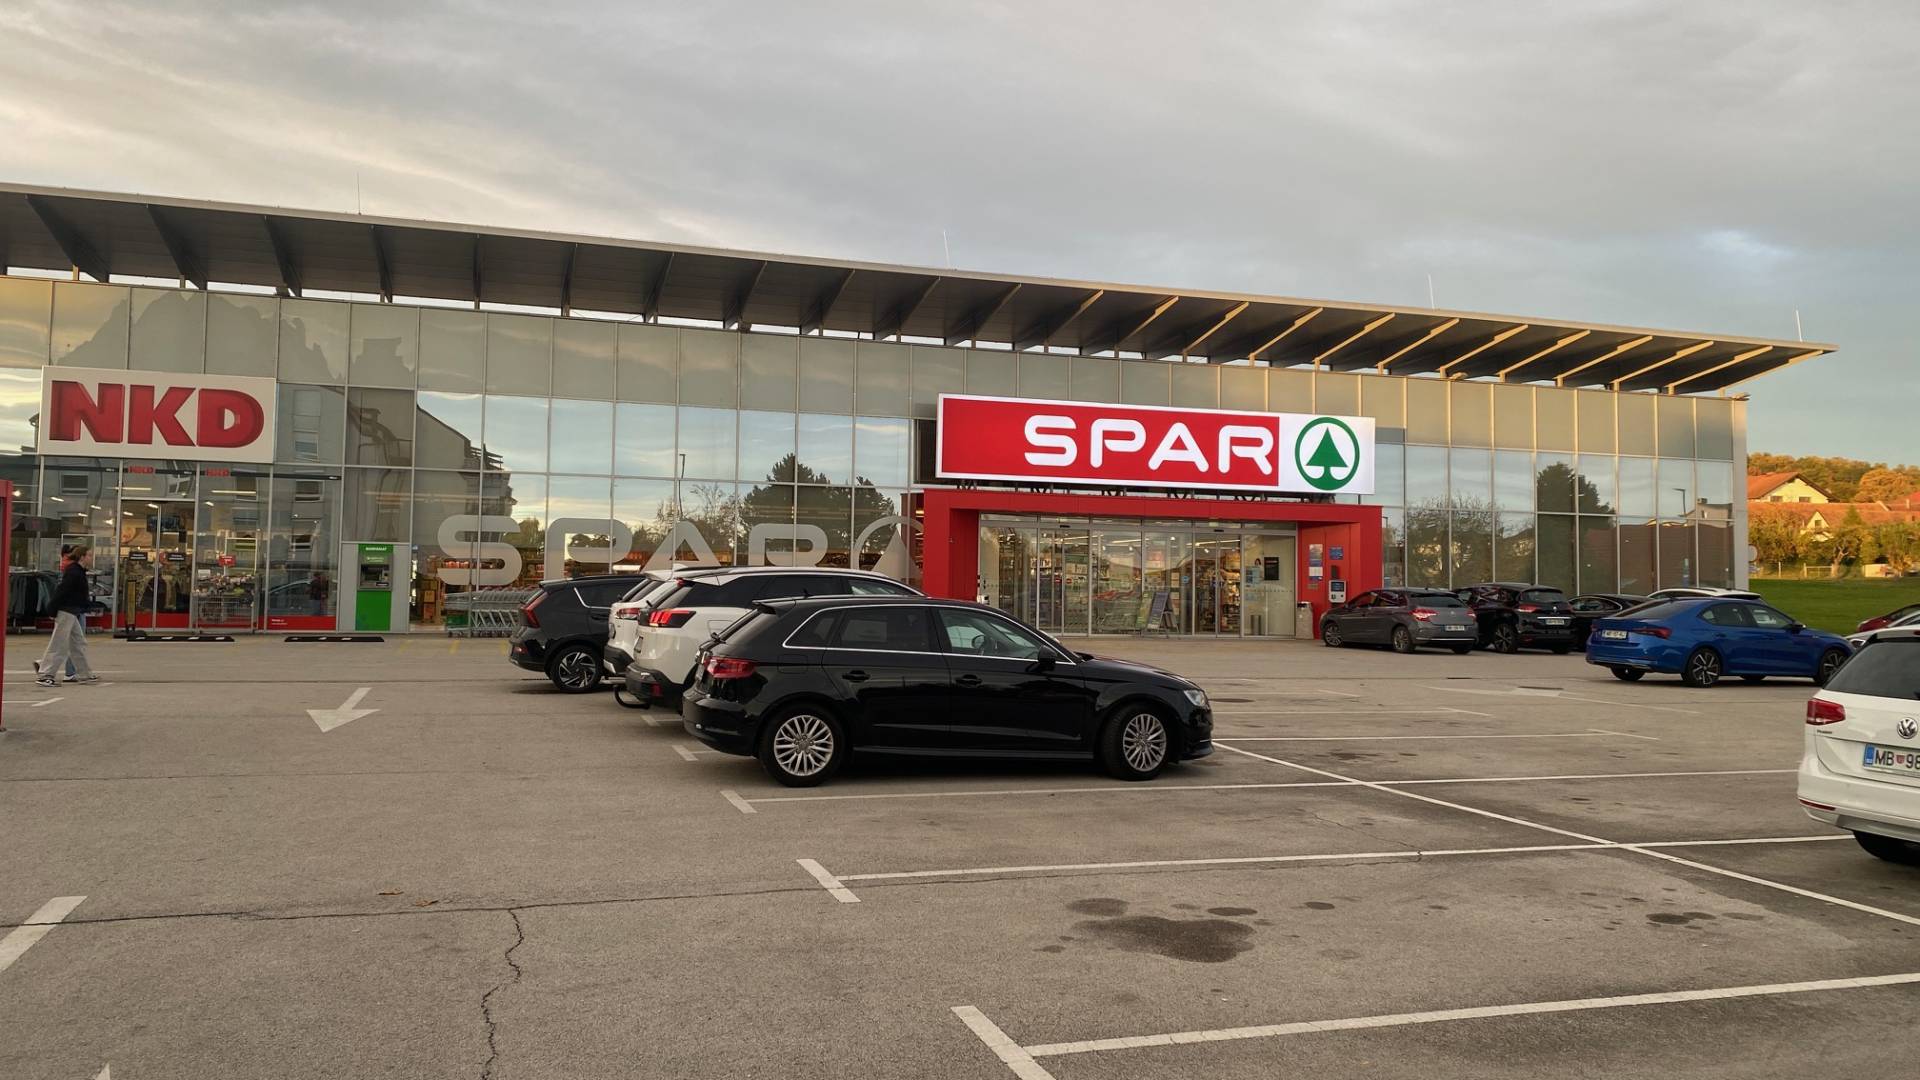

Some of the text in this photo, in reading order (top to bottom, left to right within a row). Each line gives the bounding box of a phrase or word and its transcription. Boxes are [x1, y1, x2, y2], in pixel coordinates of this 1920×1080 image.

[49, 380, 264, 448] NKD
[1024, 414, 1273, 475] SPAR
[433, 515, 829, 586] SPAR
[1875, 749, 1894, 766] MB
